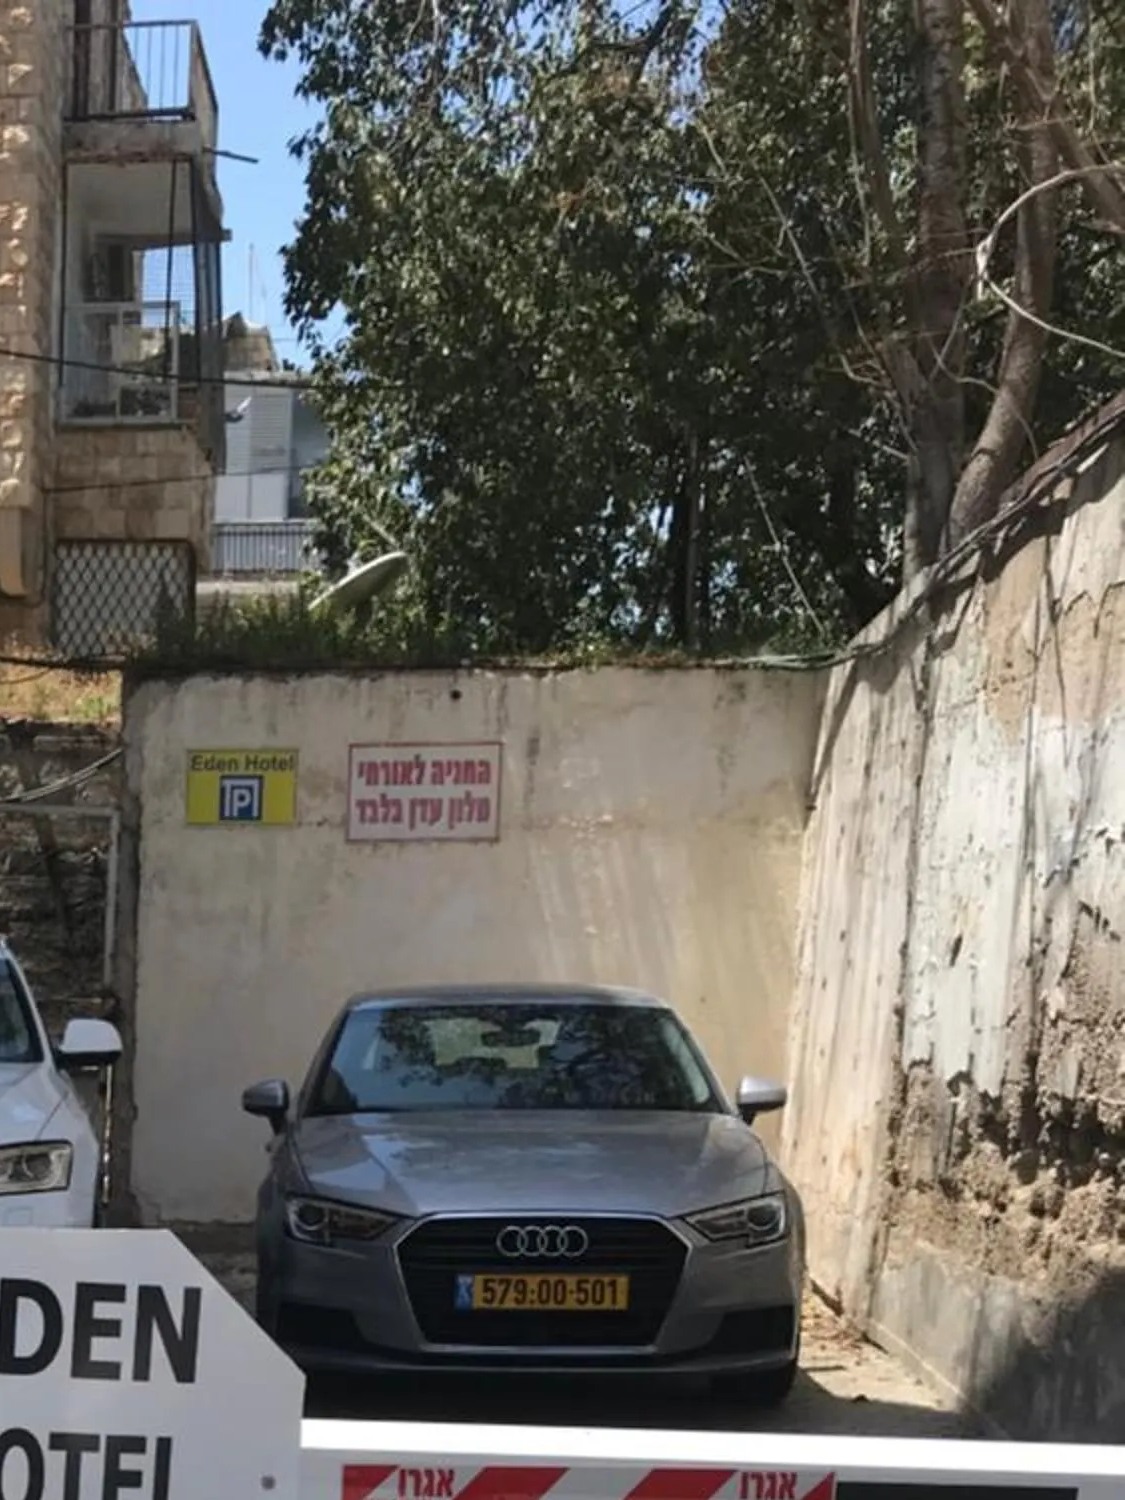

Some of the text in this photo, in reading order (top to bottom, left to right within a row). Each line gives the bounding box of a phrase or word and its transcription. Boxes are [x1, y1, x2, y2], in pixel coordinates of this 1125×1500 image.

[191, 754, 294, 771] Eden Hotel
[357, 754, 491, 786] החניה לאורחי
[355, 790, 491, 831] מלון עדן בלבד
[398, 1468, 454, 1497] אגרו
[740, 1471, 797, 1500] אגרו
